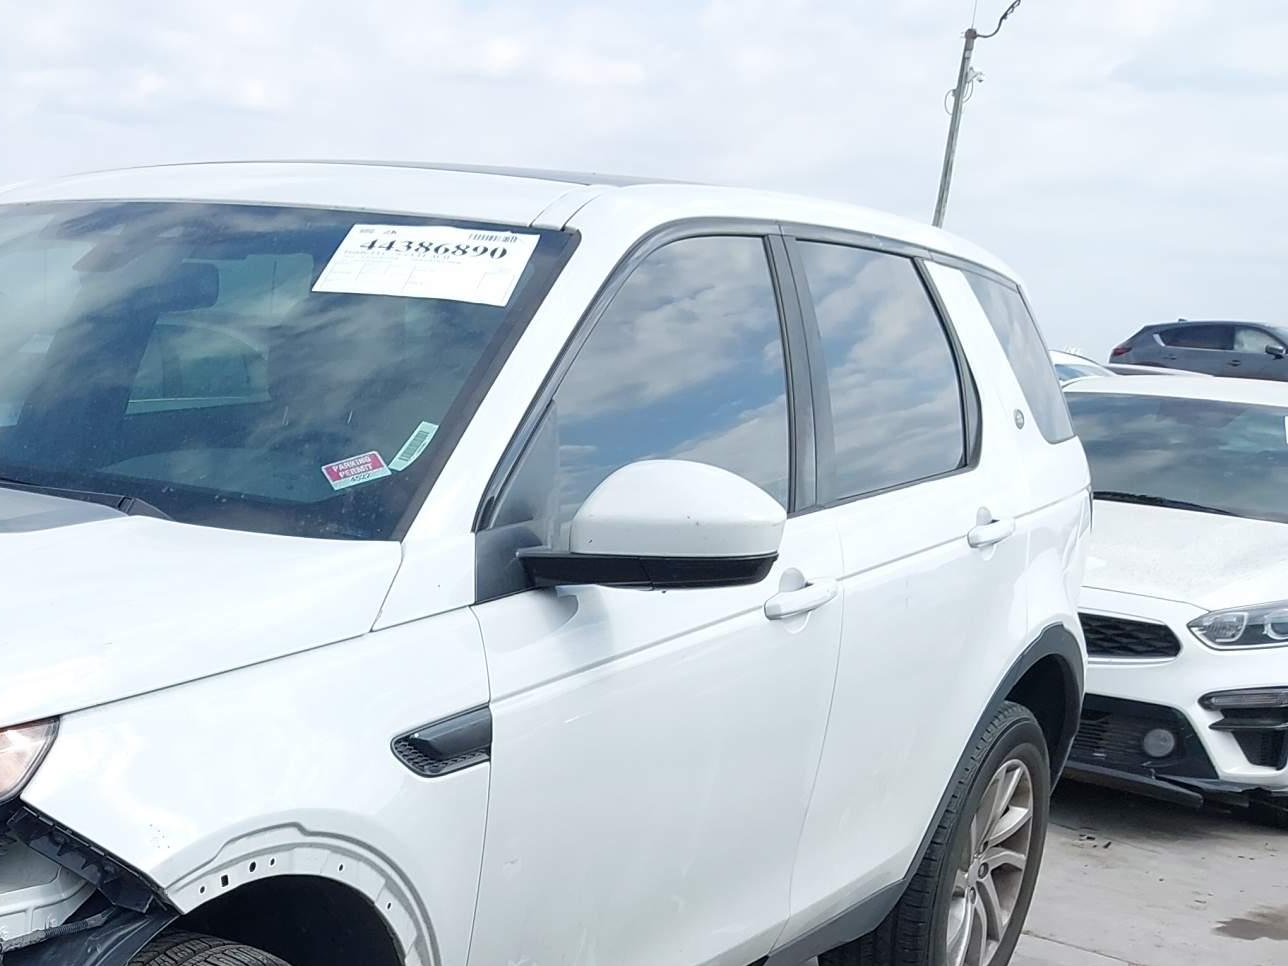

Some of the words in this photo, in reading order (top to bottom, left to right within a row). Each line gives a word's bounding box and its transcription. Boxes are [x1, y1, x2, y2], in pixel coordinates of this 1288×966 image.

[360, 239, 508, 260] 44386890
[332, 456, 371, 472] PARKING
[339, 463, 373, 478] PERMIT
